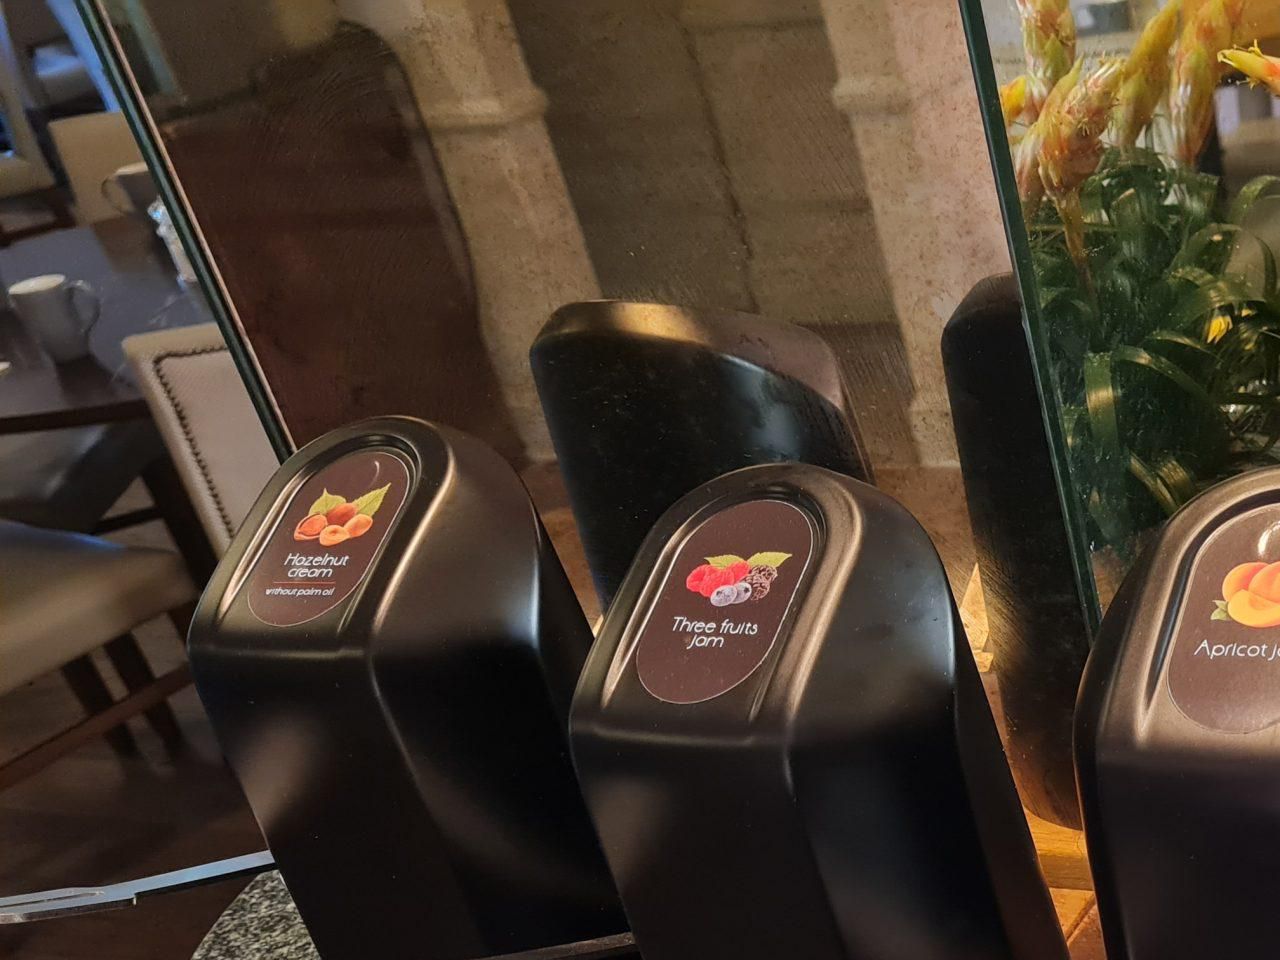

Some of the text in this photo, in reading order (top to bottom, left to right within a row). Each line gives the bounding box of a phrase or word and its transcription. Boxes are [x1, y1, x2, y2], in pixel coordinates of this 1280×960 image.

[283, 552, 350, 566] Hazelnut
[287, 566, 333, 578] cream
[265, 586, 336, 597] without palm oil
[672, 616, 758, 635] Three fruits
[686, 634, 725, 650] jam
[1193, 639, 1268, 660] Apricot
